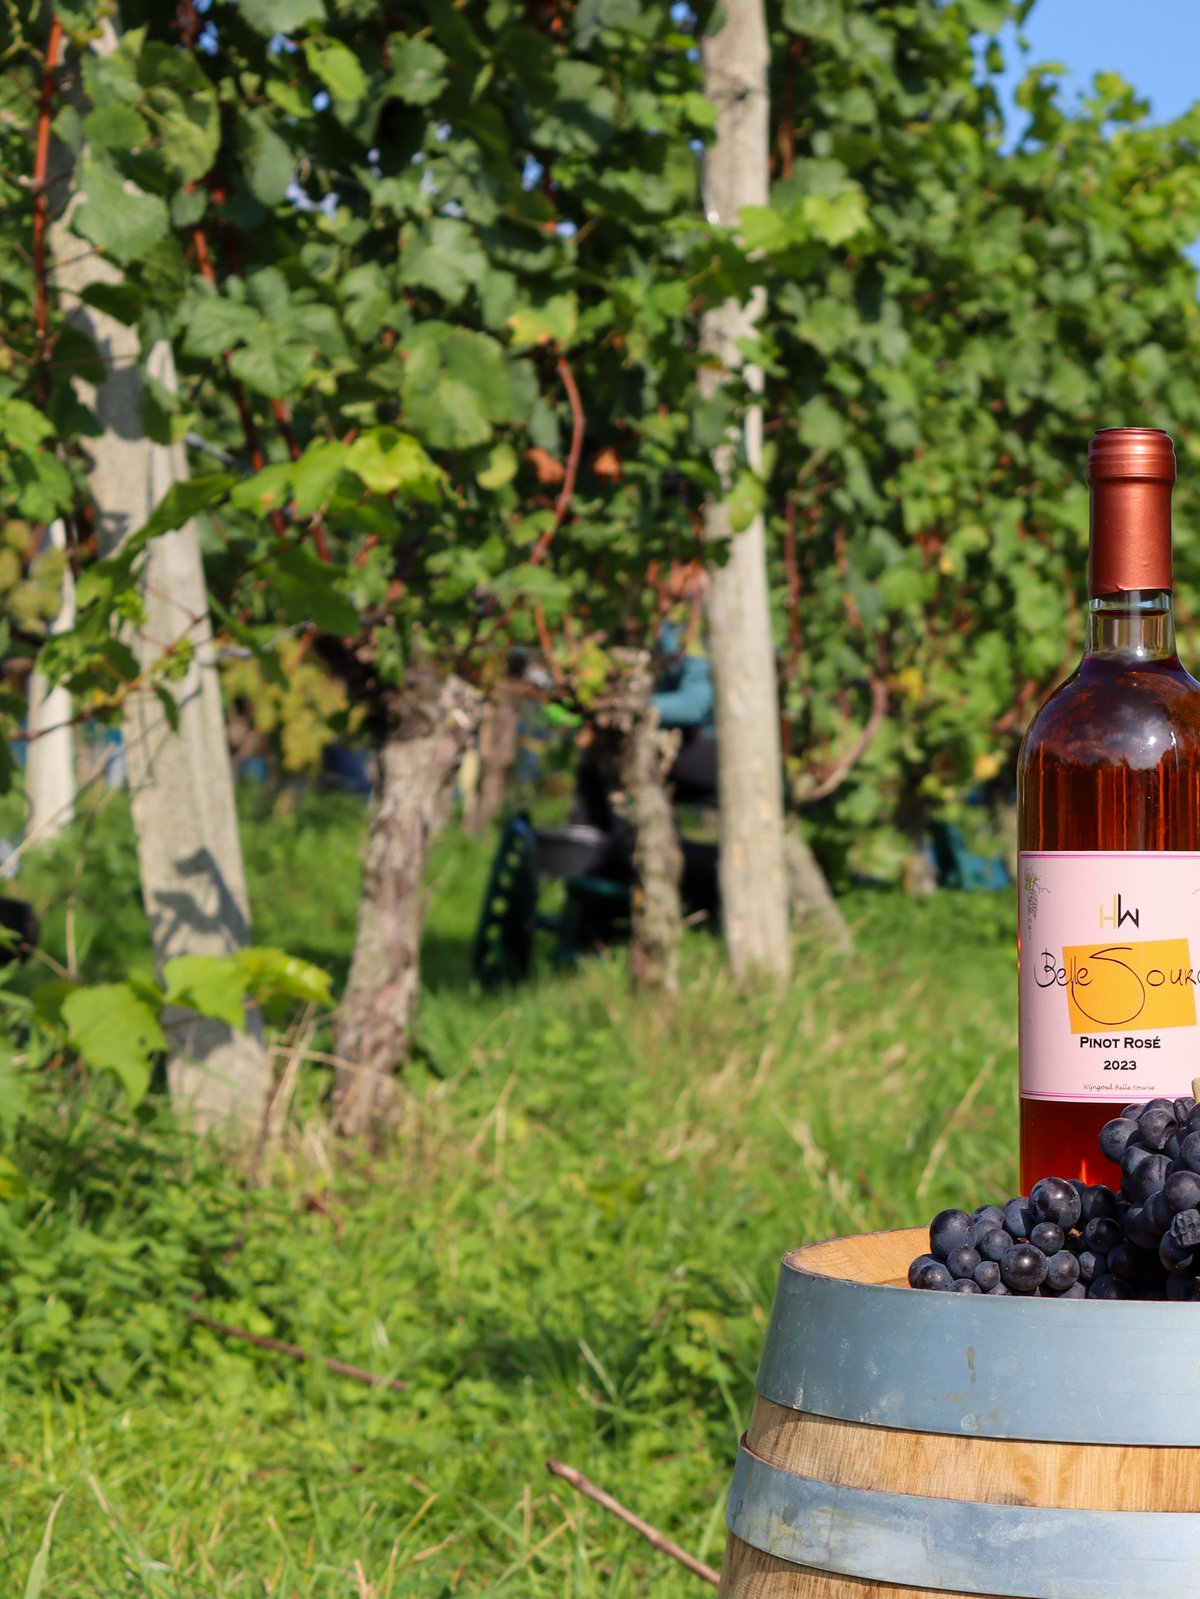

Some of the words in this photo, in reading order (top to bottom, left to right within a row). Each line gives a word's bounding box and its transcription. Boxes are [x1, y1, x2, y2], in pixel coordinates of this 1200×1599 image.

[1033, 947, 1093, 988] Belle
[1103, 1060, 1137, 1071] 2023
[1115, 1083, 1131, 1091] Belle
